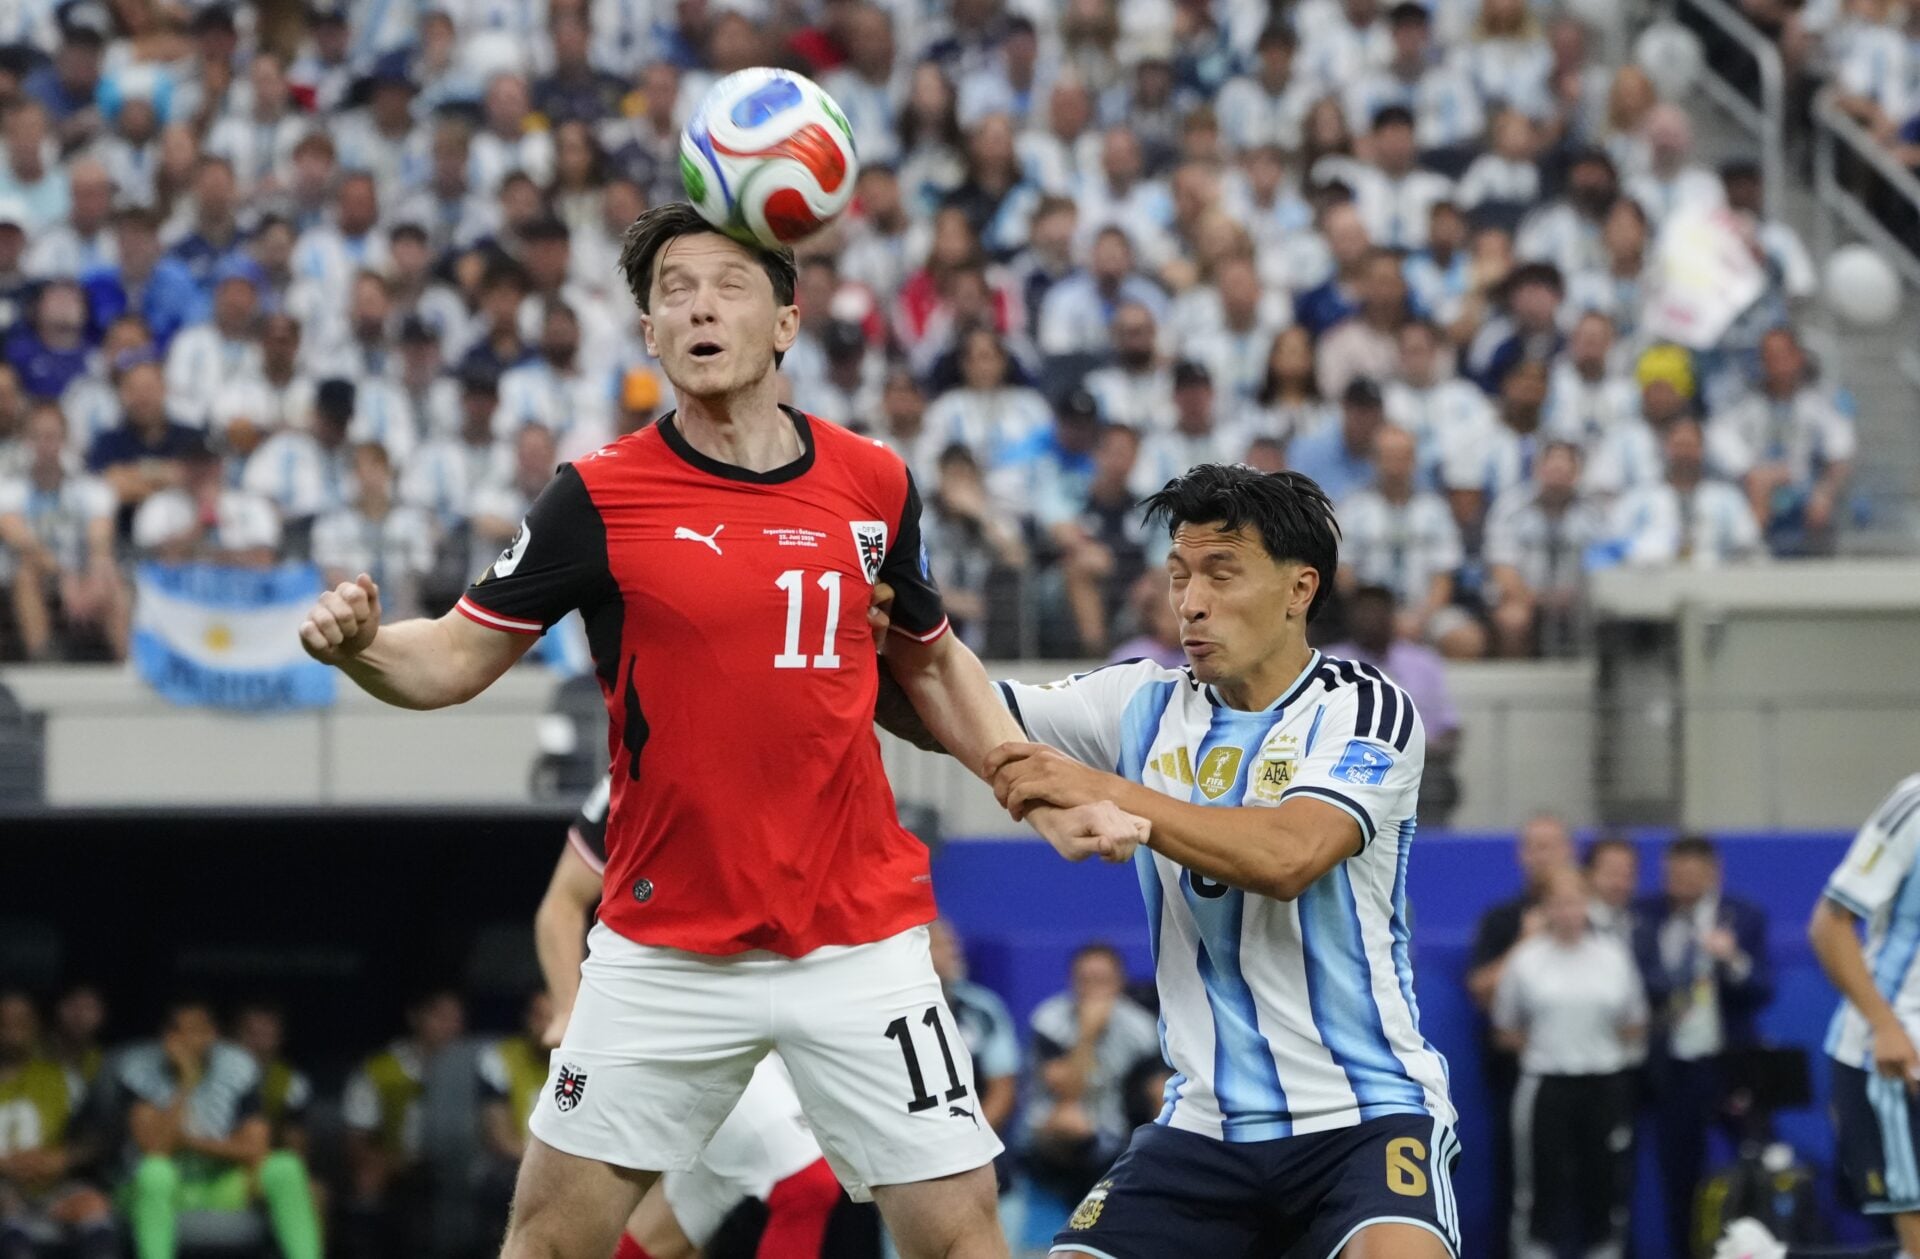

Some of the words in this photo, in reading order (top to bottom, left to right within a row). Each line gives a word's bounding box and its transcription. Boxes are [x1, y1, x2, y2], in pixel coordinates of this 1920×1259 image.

[774, 569, 843, 669] 11
[1206, 777, 1224, 788] FIFA
[1263, 761, 1289, 785] AFA
[1346, 767, 1370, 784] PEACE
[884, 1005, 968, 1114] 11
[1386, 1137, 1427, 1197] 6
